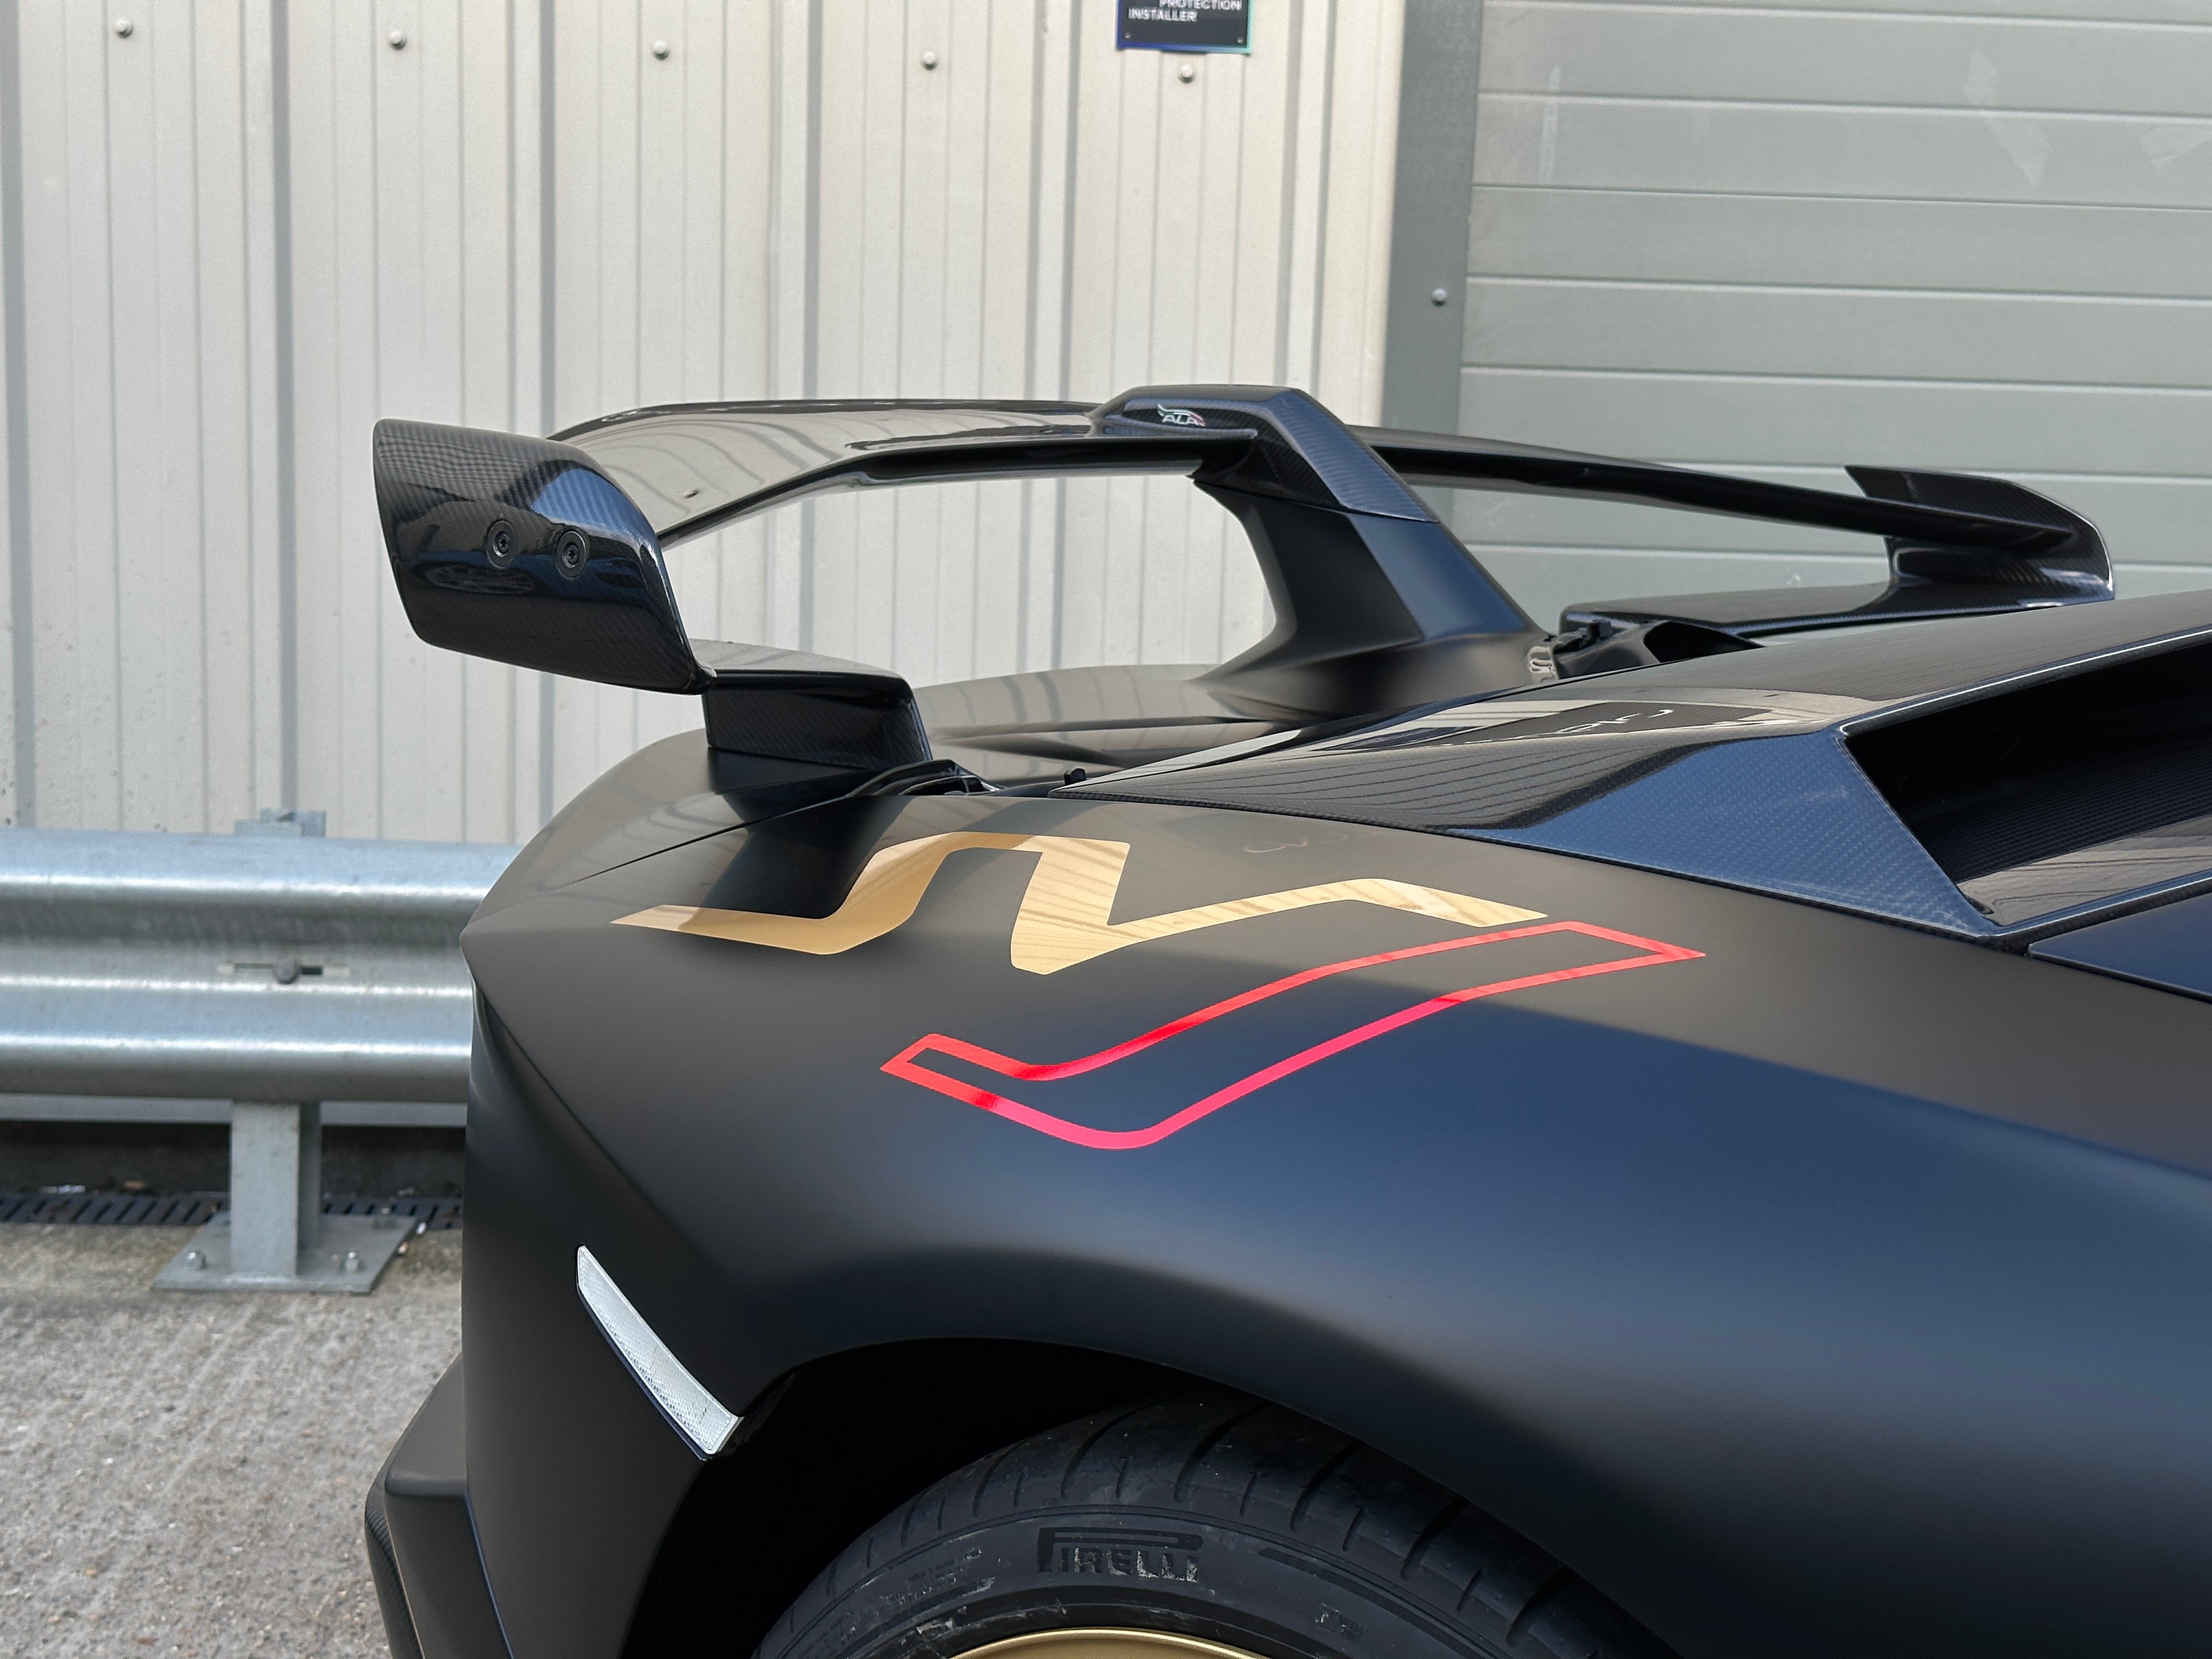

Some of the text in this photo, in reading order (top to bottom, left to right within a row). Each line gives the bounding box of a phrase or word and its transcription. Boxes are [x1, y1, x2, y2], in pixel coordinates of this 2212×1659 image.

[1159, 0, 1242, 10] PROTECTION
[1128, 7, 1198, 22] INSTALLER
[1161, 414, 1200, 426] ALA
[1037, 1527, 1203, 1583] PIRELLI
